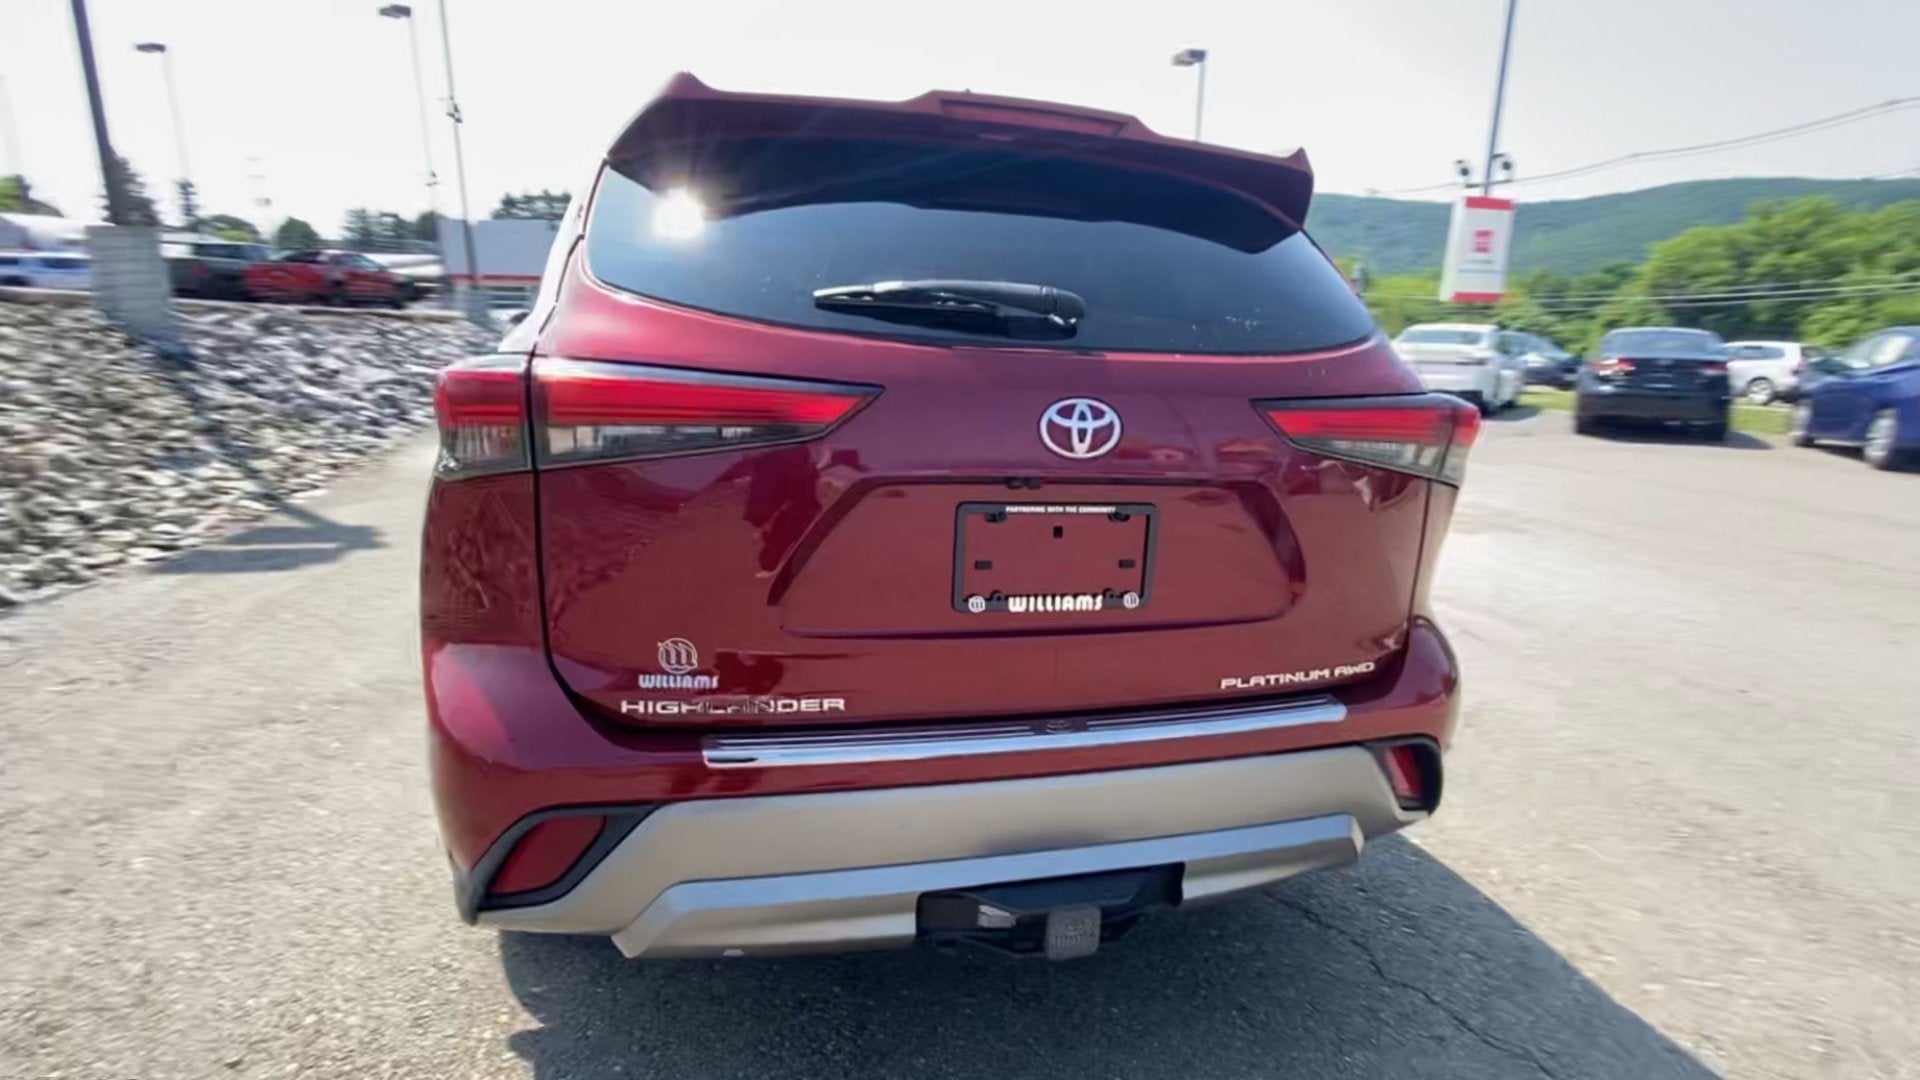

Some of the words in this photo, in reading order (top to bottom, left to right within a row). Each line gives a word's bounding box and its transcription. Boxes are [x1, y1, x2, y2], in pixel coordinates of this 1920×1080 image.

[1047, 505, 1064, 513] WITH
[1065, 505, 1077, 513] THE
[1008, 595, 1103, 612] WILLIAMS
[638, 674, 719, 689] WILLIAMS
[1220, 668, 1330, 689] PLATINUM
[1334, 661, 1375, 677] AWD
[621, 698, 845, 715] HIGHLANDER
